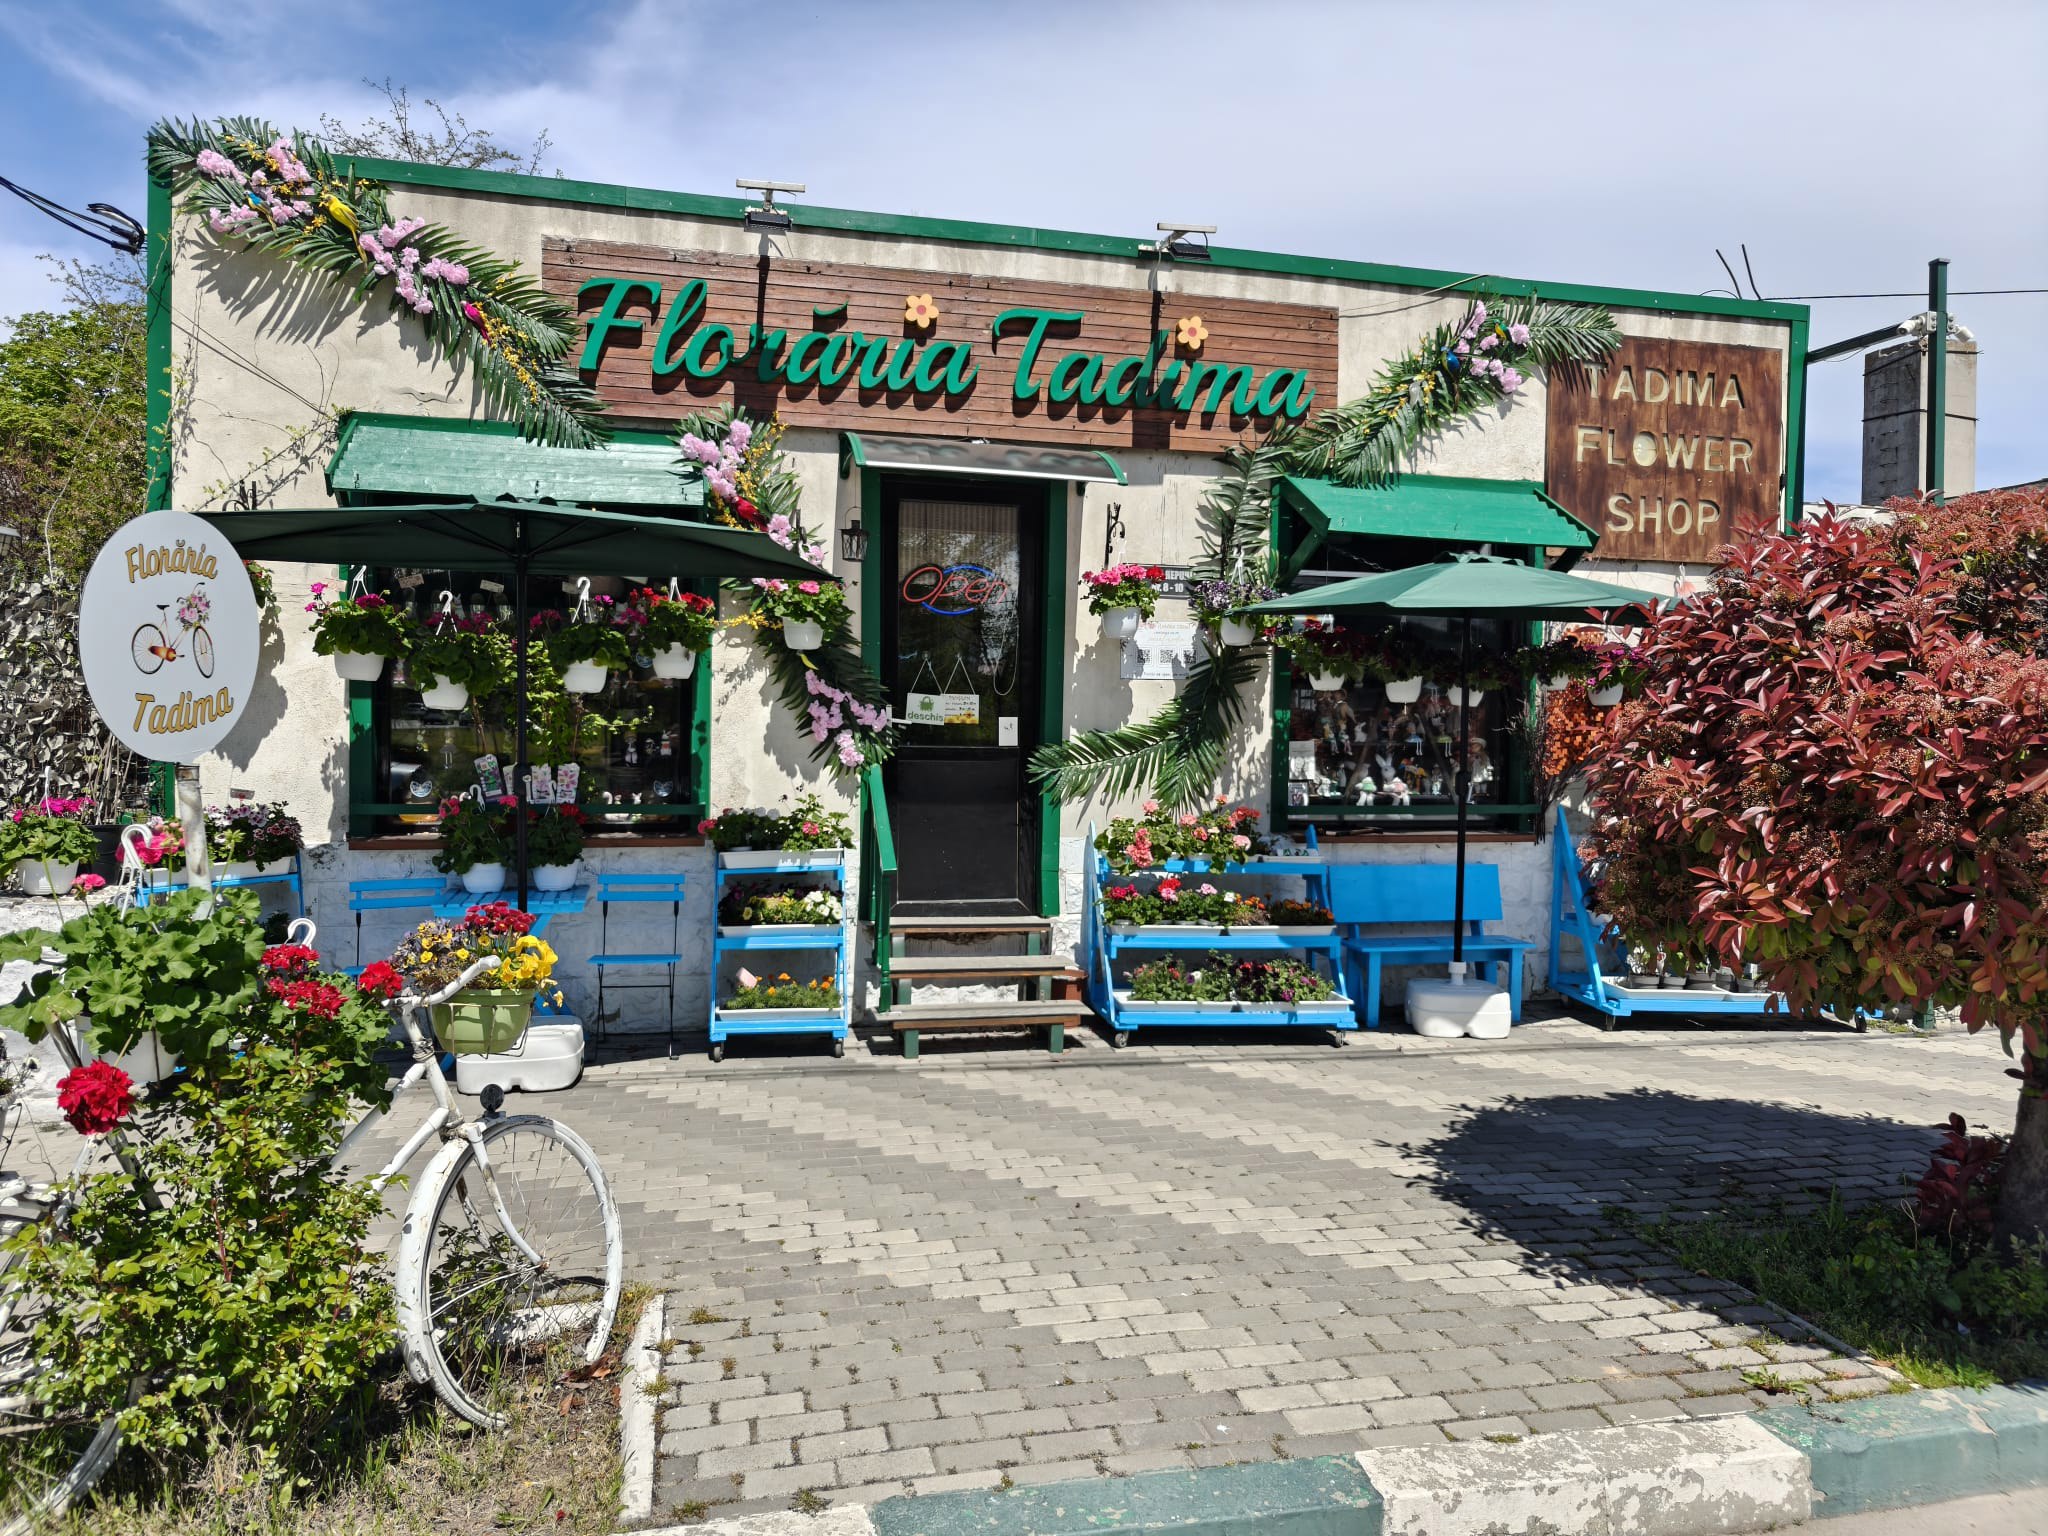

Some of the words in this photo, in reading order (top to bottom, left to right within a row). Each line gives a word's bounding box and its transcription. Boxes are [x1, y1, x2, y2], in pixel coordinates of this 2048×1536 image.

[577, 277, 980, 395] Florăria
[992, 308, 1315, 418] Tadima
[1584, 361, 1745, 409] TADIMA
[1575, 424, 1753, 473] FLOWER
[1606, 492, 1721, 536] SHOP
[124, 540, 218, 584] Florăria
[903, 566, 1007, 605] Open
[1174, 583, 1184, 593] 10
[132, 686, 234, 735] Tadima
[907, 711, 944, 722] deschis
